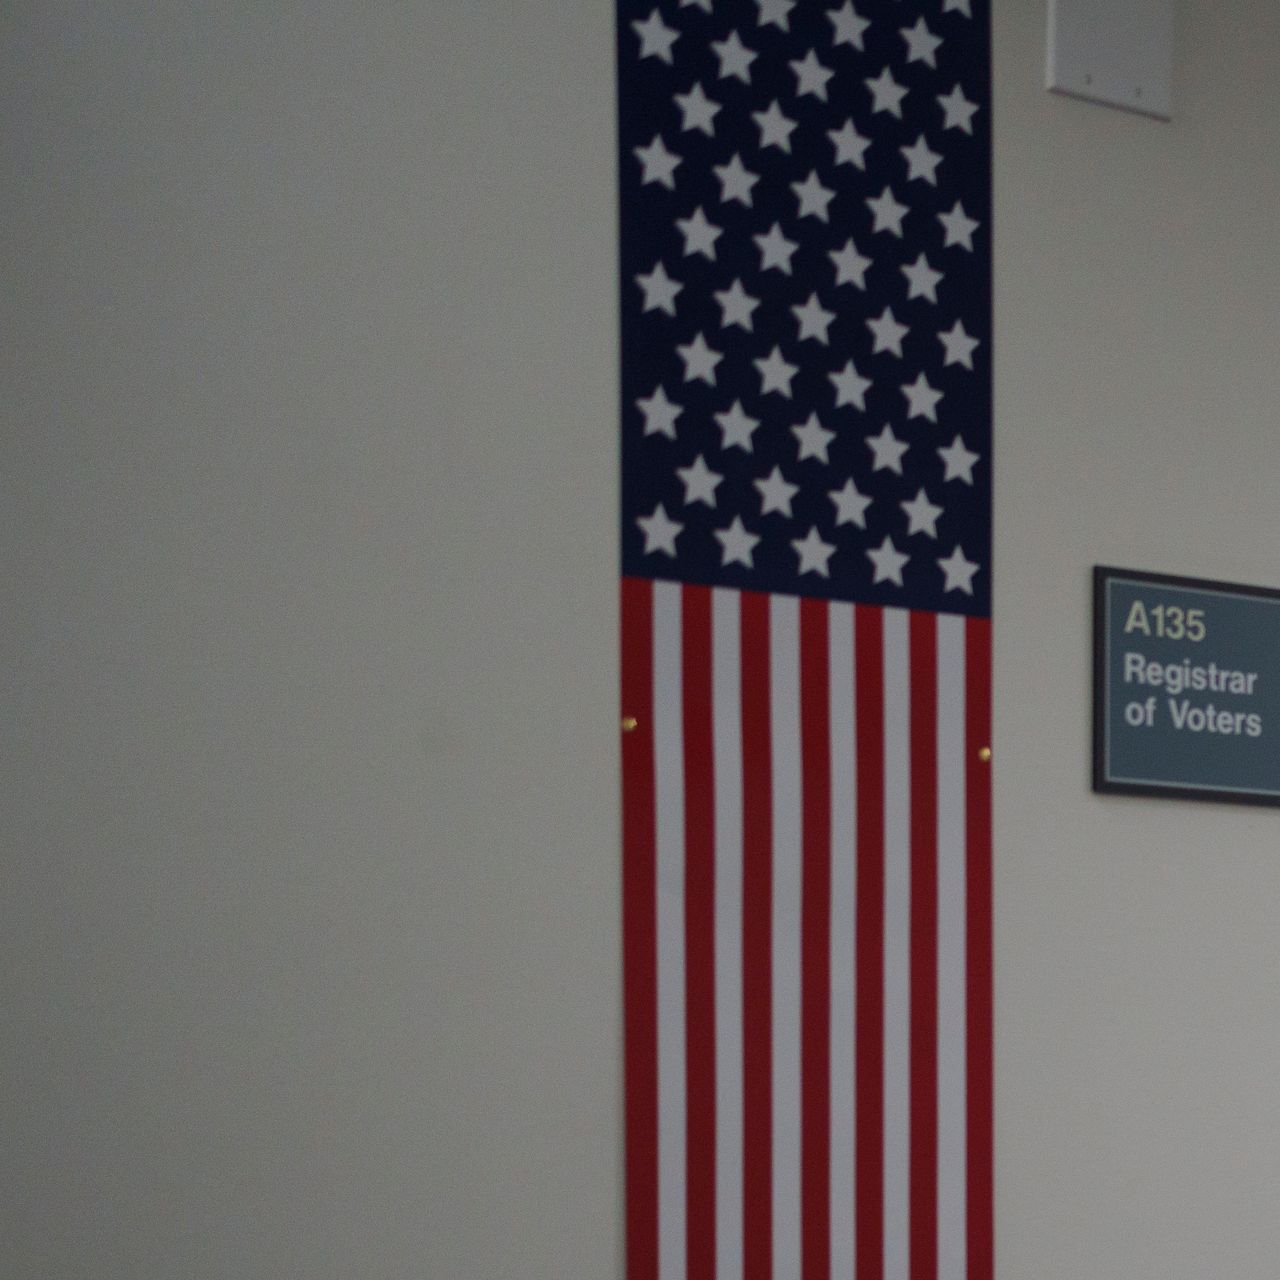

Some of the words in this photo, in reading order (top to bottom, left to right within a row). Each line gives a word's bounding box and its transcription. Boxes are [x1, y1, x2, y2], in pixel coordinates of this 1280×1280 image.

[1124, 600, 1206, 642] A135
[1124, 652, 1258, 695] Registrar
[1124, 697, 1156, 727] of
[1168, 699, 1262, 737] Voters
